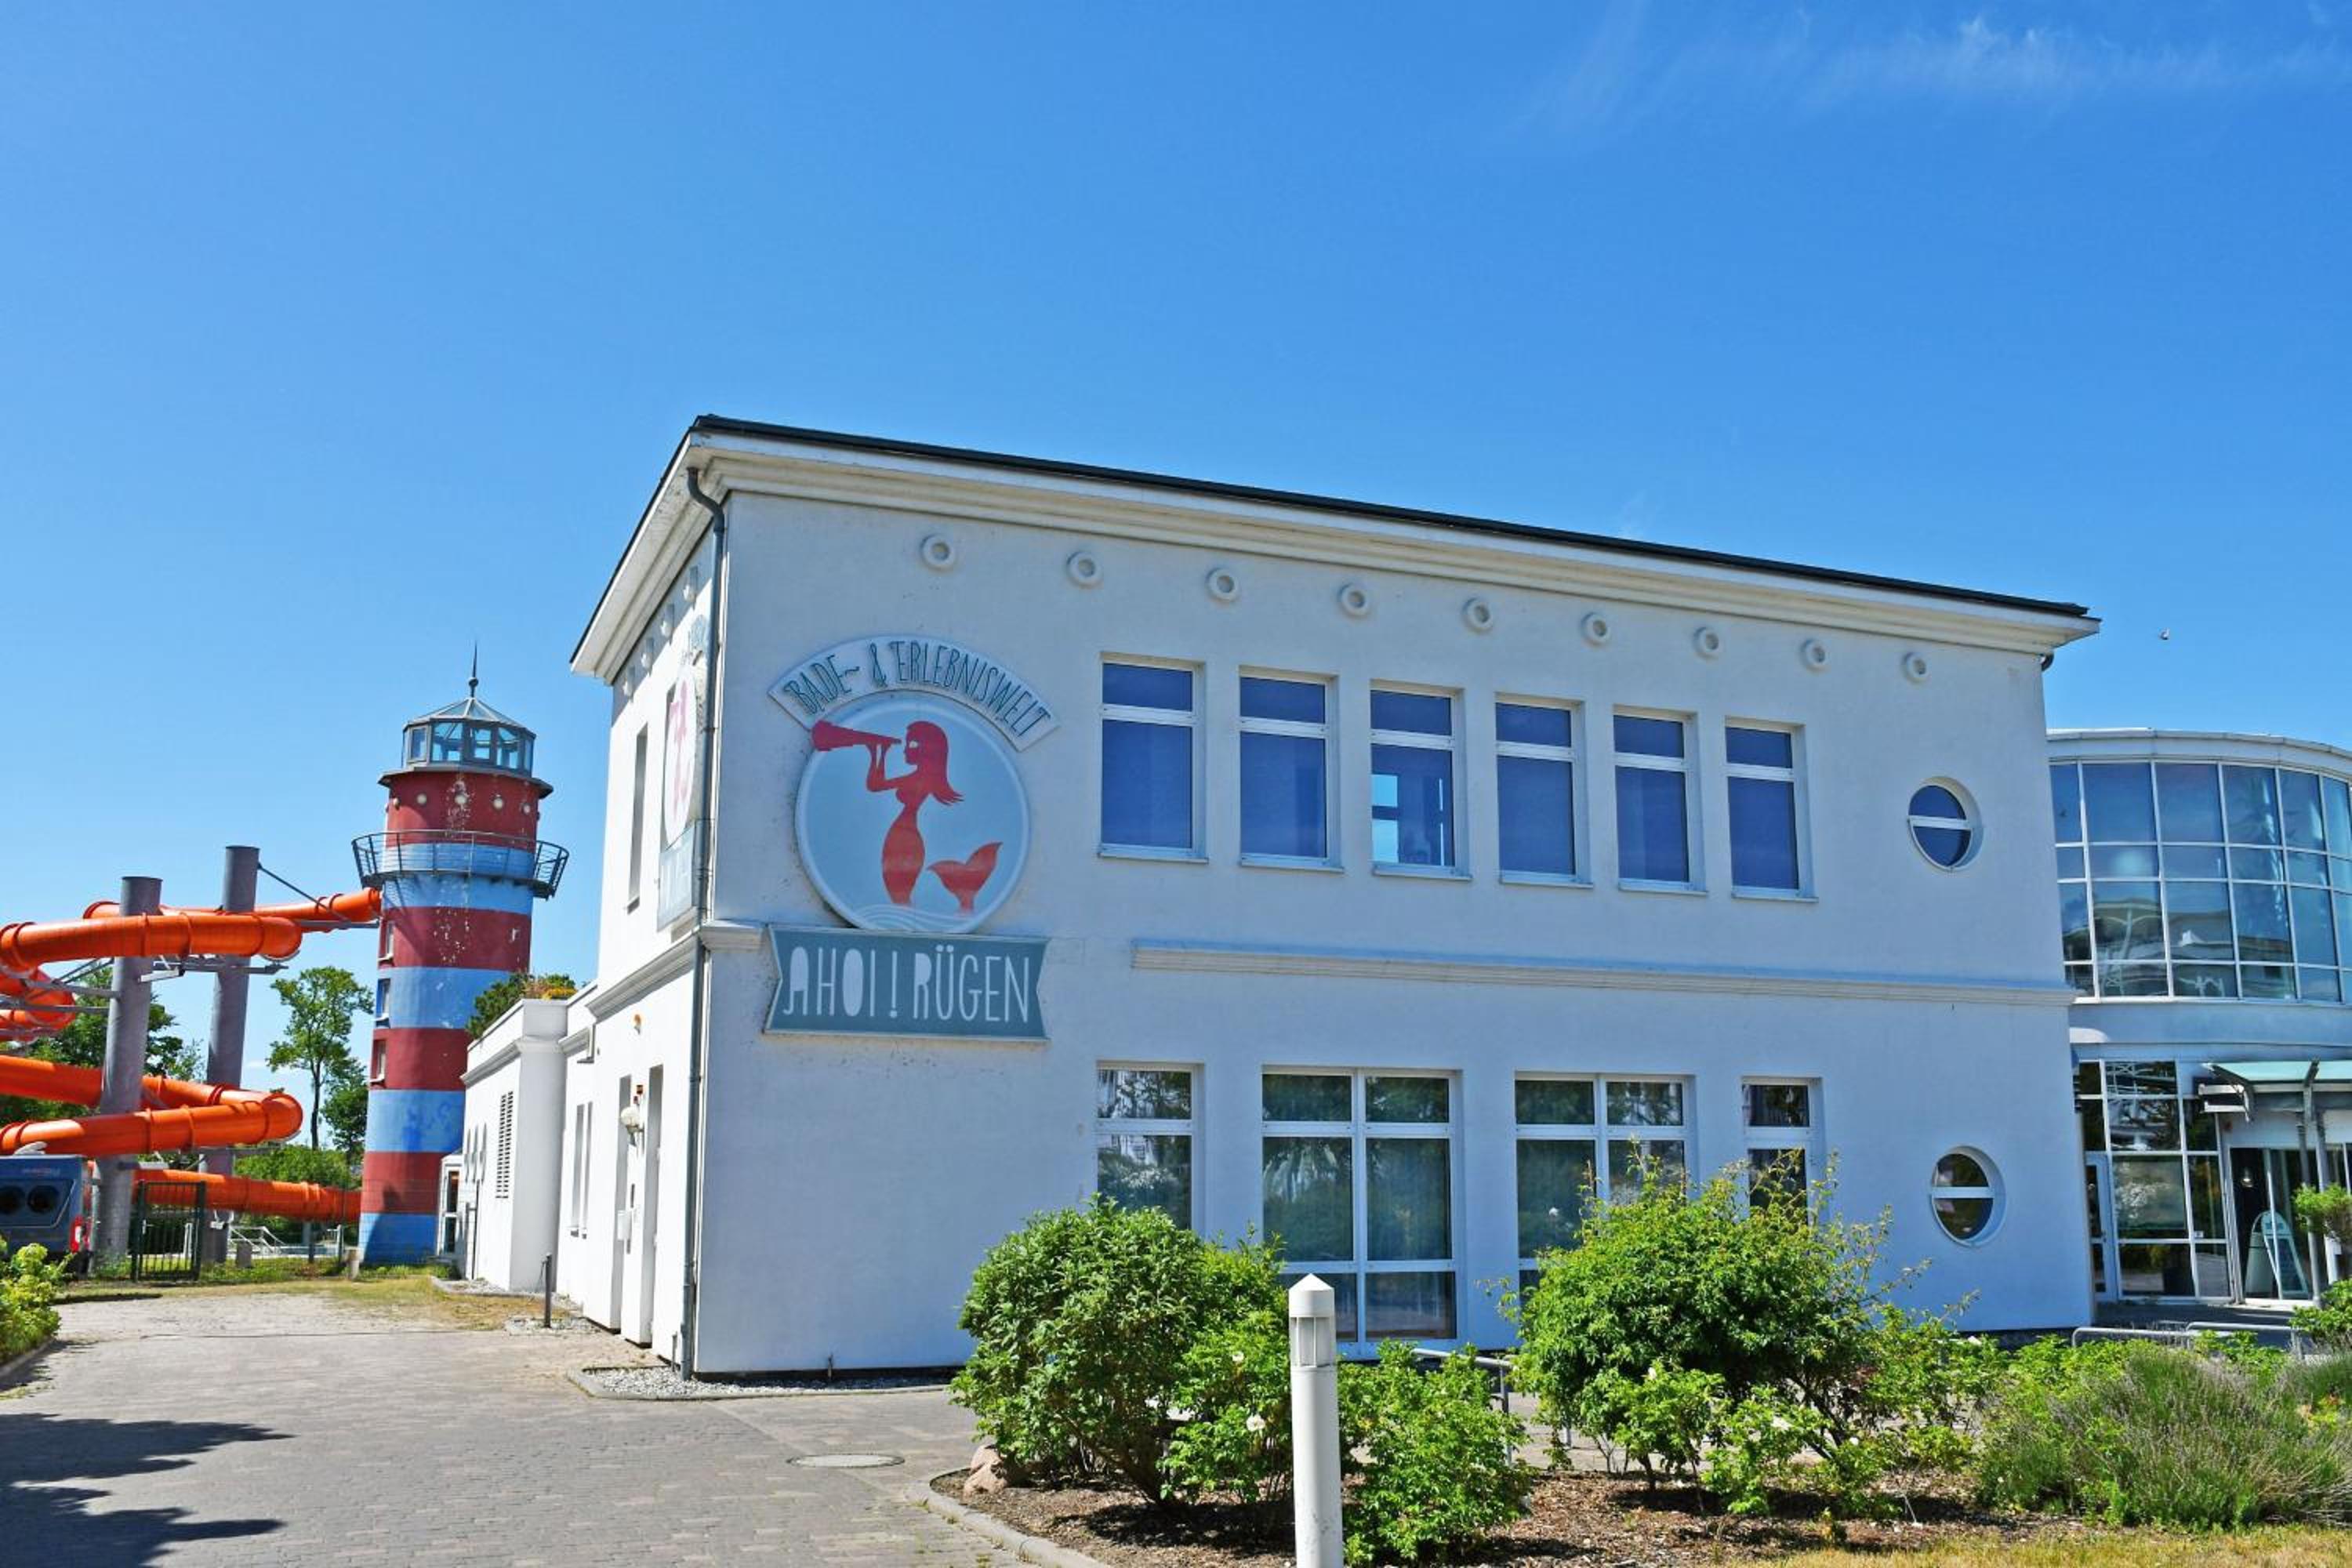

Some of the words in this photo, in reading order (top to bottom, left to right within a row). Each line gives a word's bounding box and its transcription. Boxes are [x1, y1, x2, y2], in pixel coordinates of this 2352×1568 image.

[869, 642, 888, 688] &
[888, 639, 1052, 739] ERLEBNISWELT
[913, 944, 1030, 1024] RÜGEN
